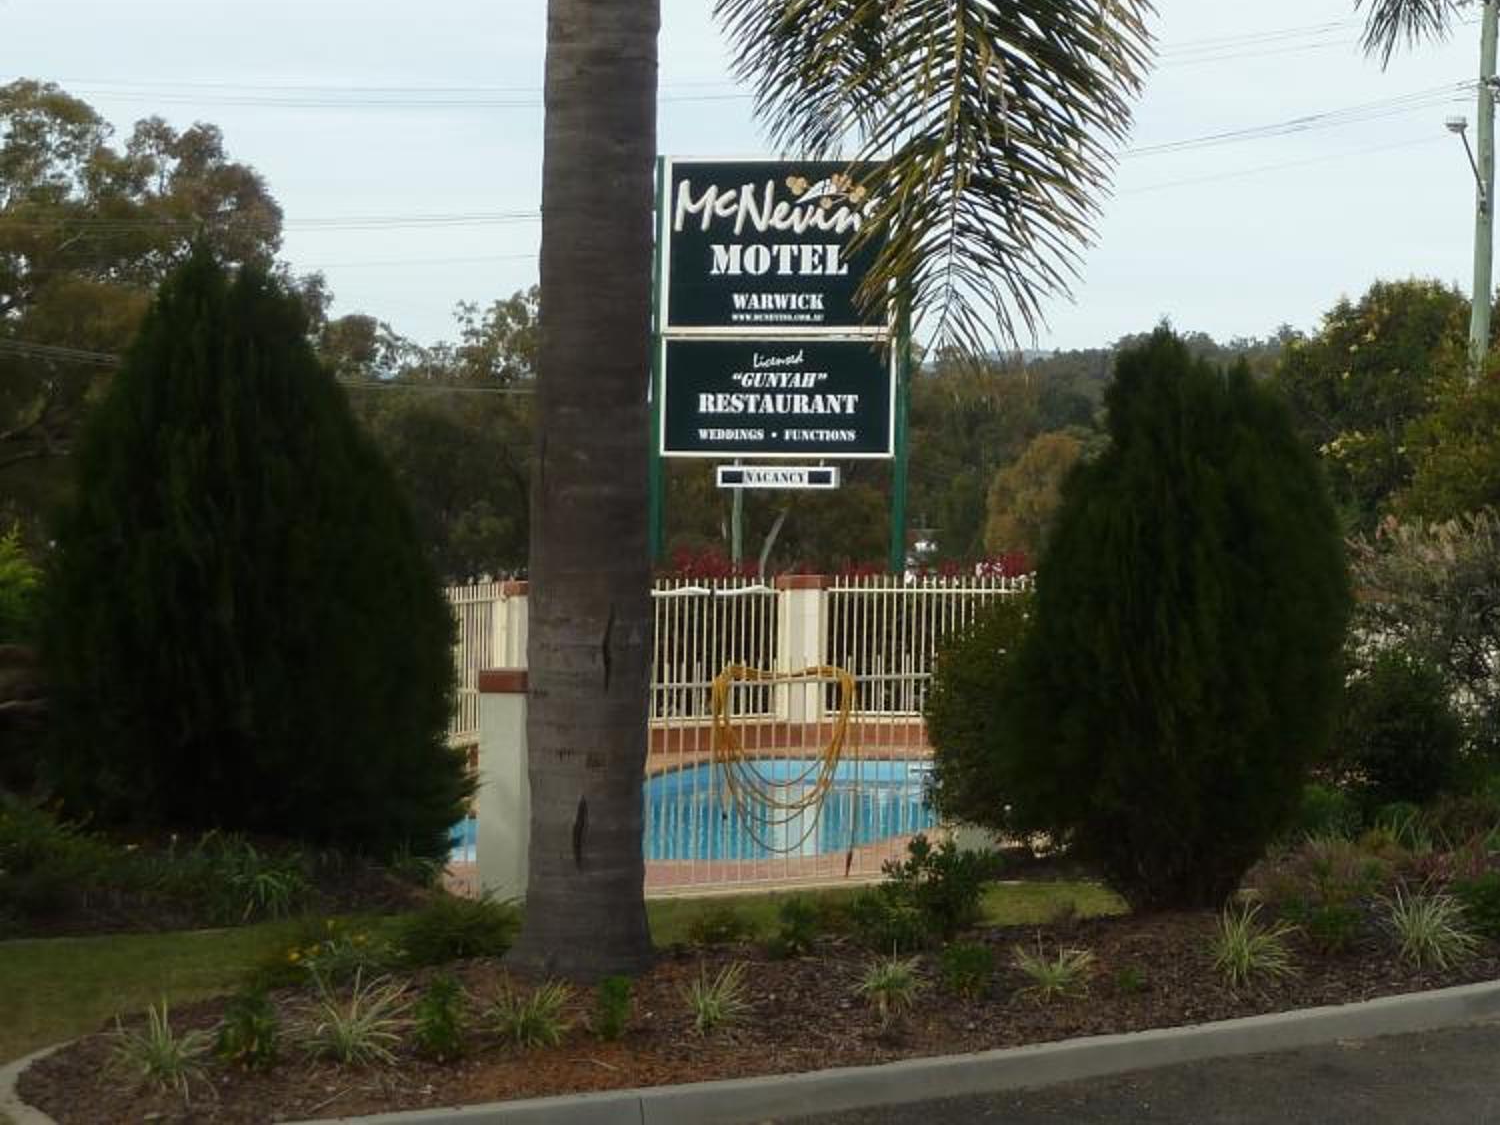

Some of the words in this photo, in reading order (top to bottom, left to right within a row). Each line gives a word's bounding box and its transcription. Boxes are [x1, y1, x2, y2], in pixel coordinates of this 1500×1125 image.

[709, 244, 849, 276] MOTEL
[732, 293, 825, 310] WARWICK
[753, 349, 804, 369] Licensed
[698, 393, 859, 414] RESTAURANT
[698, 428, 765, 442] WEDDINGS
[784, 428, 857, 443] FUNCTIONS
[745, 471, 805, 484] VACANCY
